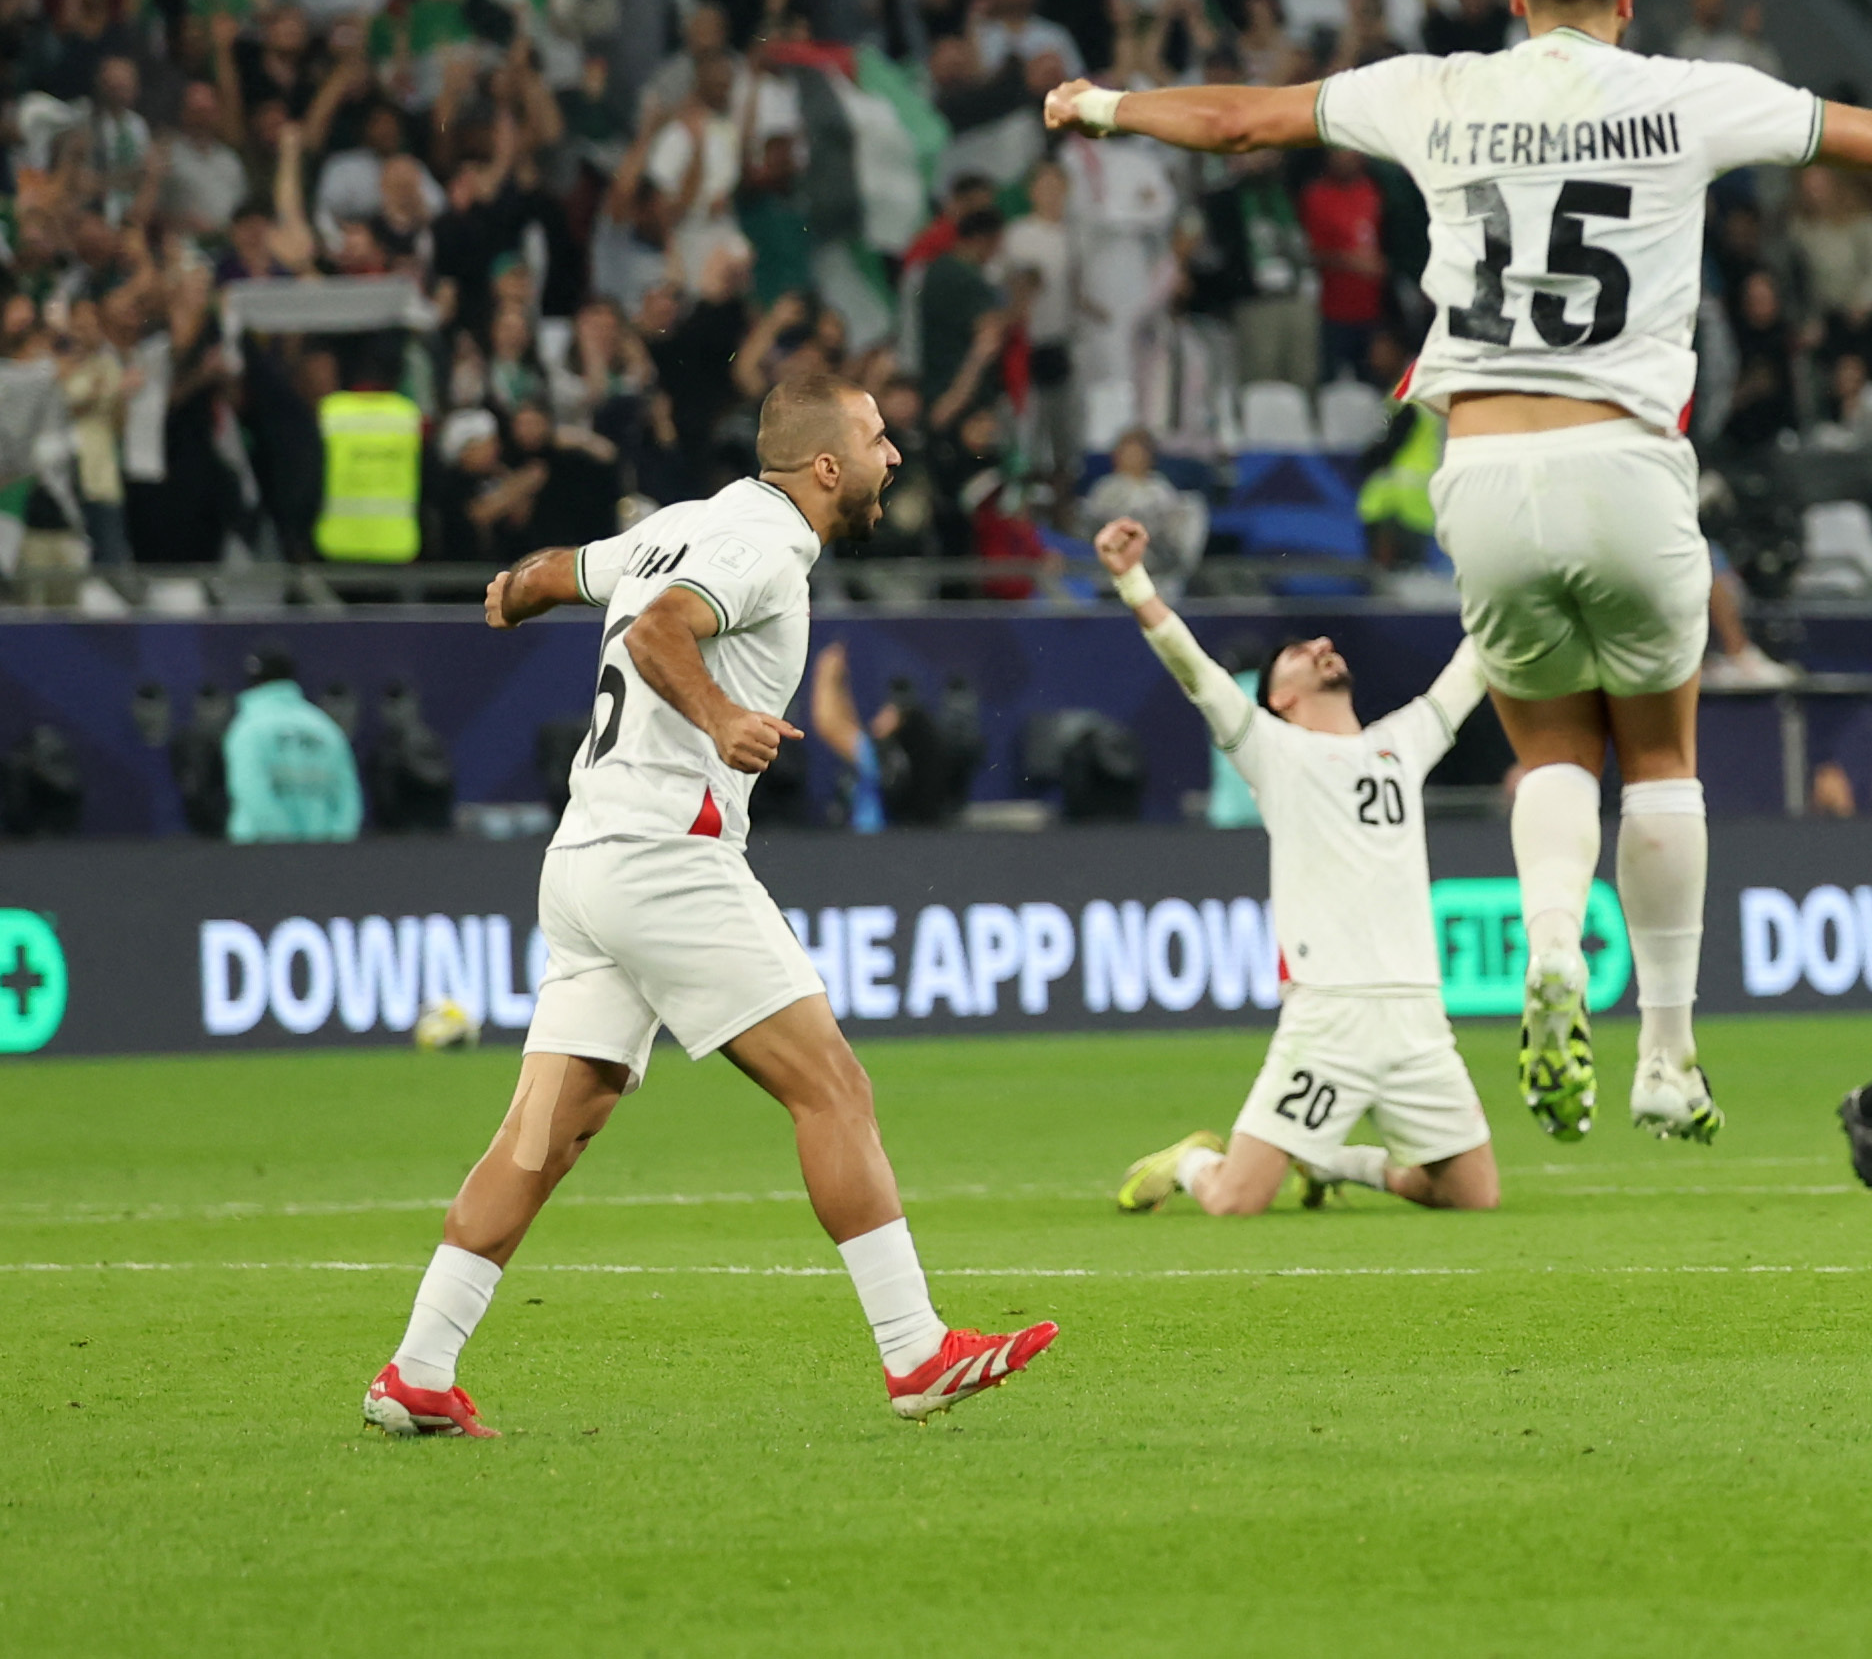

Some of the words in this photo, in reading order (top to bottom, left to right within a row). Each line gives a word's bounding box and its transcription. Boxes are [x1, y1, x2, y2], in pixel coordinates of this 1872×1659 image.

[1448, 179, 1633, 348] 15
[1355, 776, 1404, 825] 20
[201, 914, 547, 1035] DOWNL
[783, 905, 899, 1019] HE
[906, 901, 1075, 1017] APP
[1081, 896, 1281, 1013] NOW
[1276, 1070, 1337, 1131] 20
